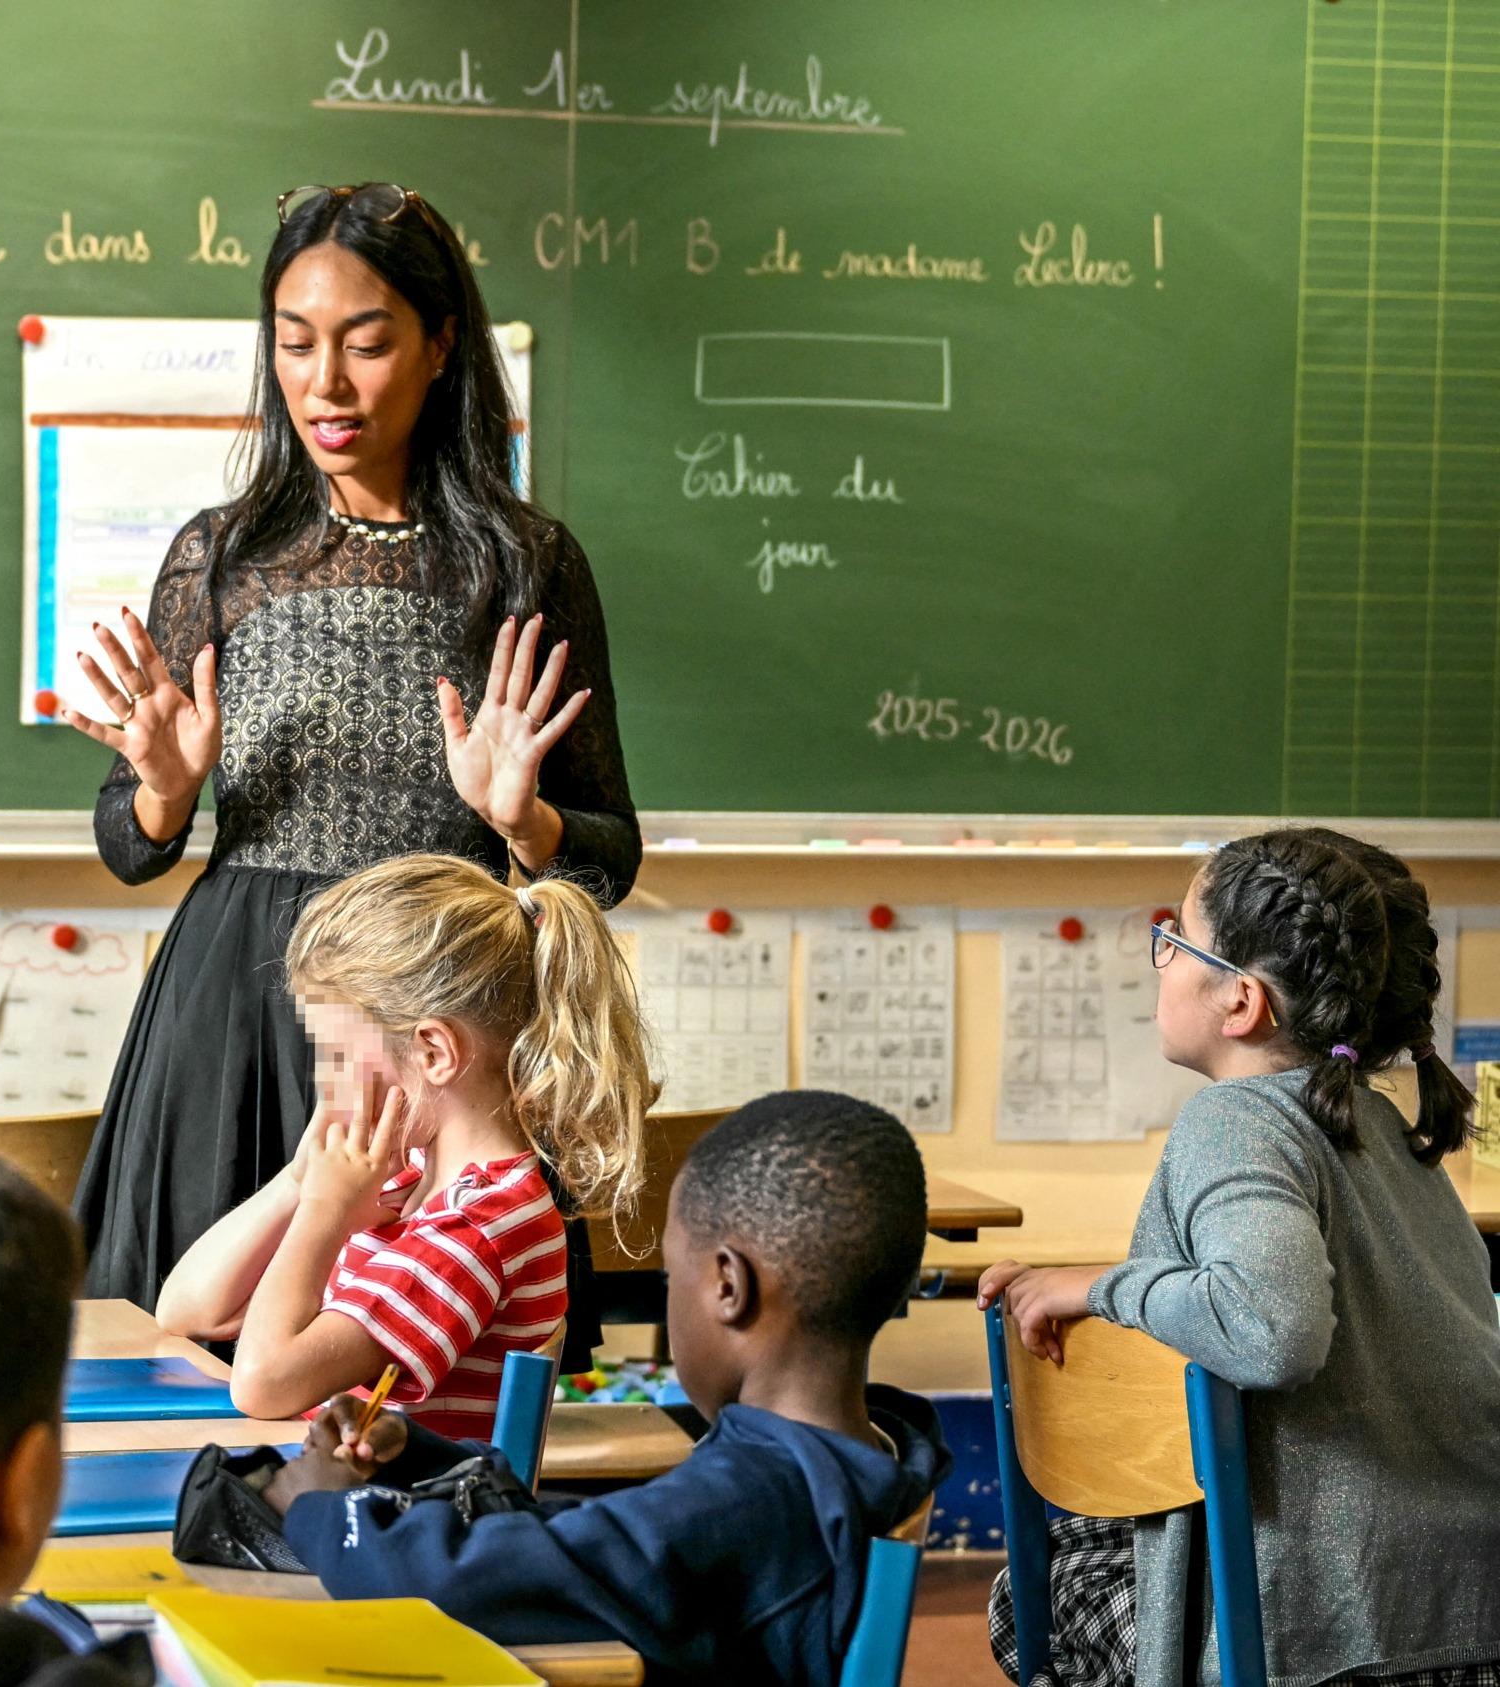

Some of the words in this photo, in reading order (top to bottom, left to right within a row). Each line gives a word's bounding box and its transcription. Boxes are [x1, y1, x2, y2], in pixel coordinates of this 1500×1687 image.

[324, 28, 494, 103] Lundi
[523, 50, 614, 110] 1er
[652, 54, 882, 148] septembre
[43, 210, 151, 265] dans
[188, 197, 252, 267] la
[533, 210, 638, 272] CM1
[686, 217, 721, 275] B
[744, 227, 803, 277] de
[822, 242, 989, 283] madame
[1013, 220, 1136, 289] Leclerc
[674, 431, 802, 501] Cahier
[831, 454, 906, 504] du
[746, 517, 841, 595] jour
[866, 688, 1074, 766] 2025-2026
